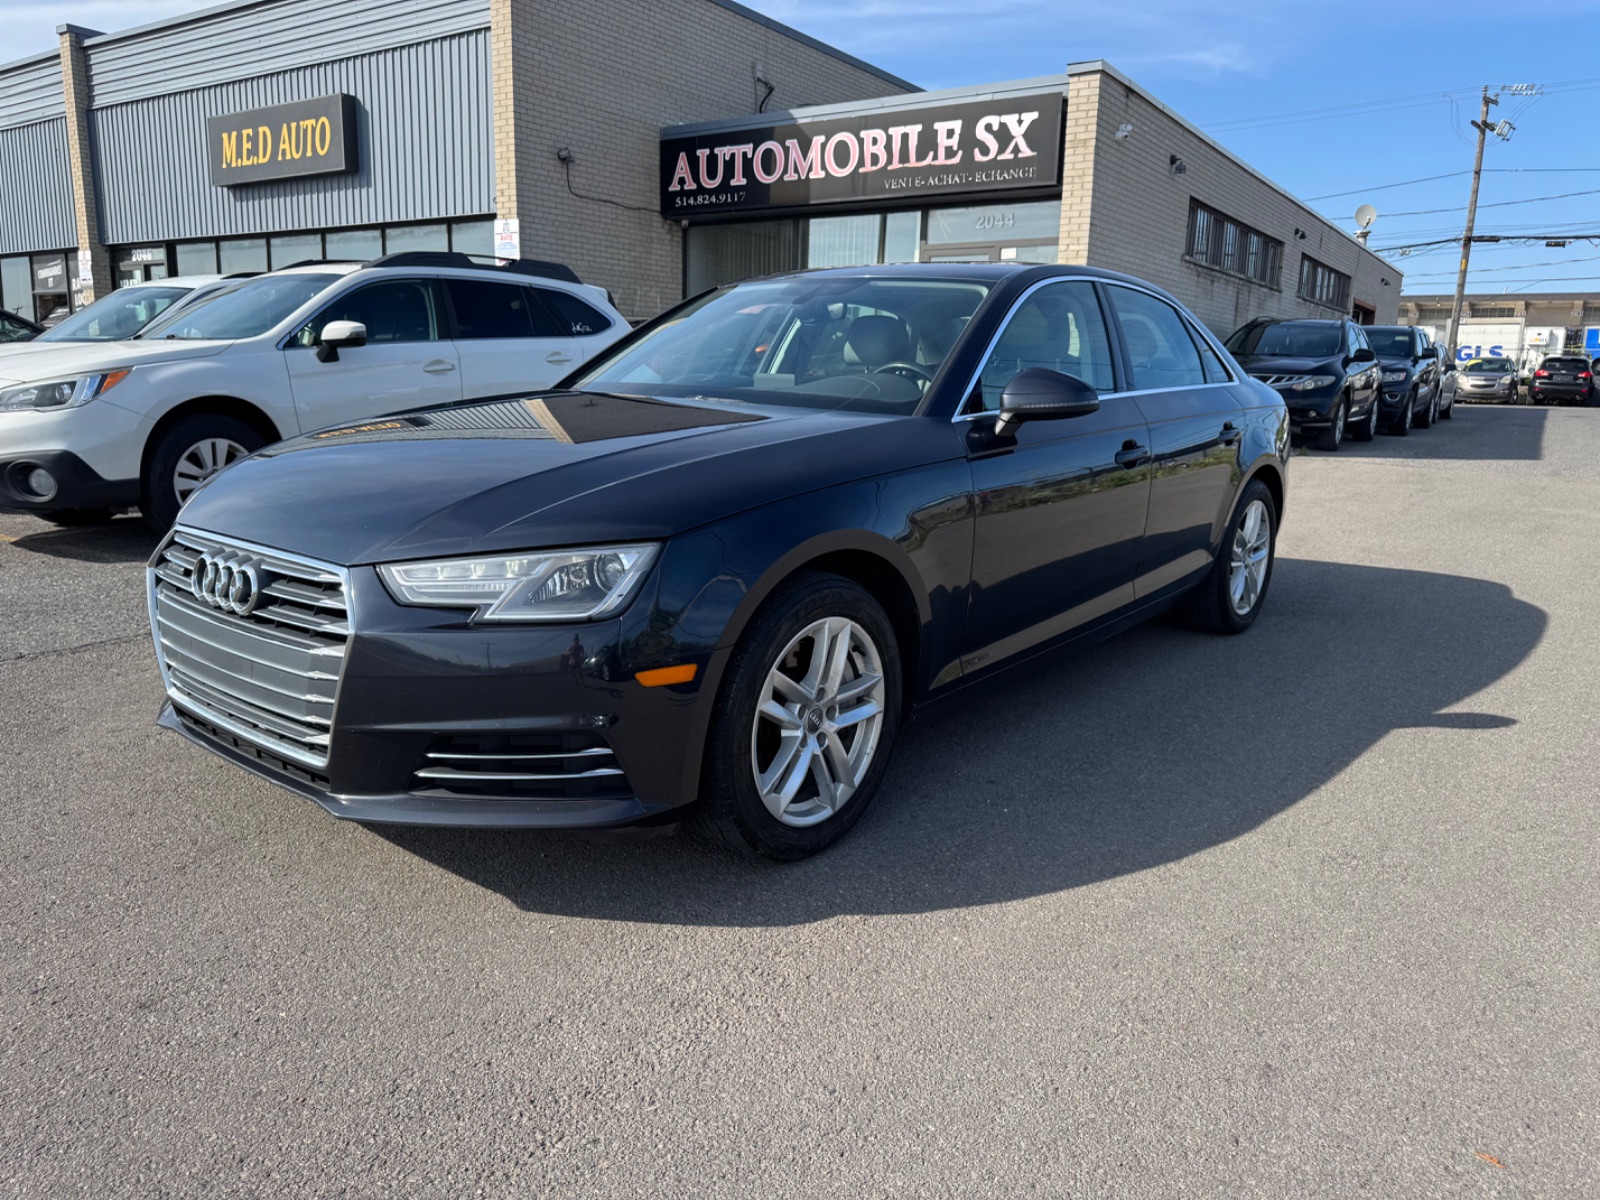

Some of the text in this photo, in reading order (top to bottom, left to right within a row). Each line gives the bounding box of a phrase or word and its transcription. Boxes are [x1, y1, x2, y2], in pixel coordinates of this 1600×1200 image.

[222, 116, 331, 169] M.E.D AUTO
[668, 111, 1039, 192] AUTOMOBILE SX
[675, 191, 746, 207] 514.824.9117
[975, 212, 1015, 229] 2044
[1457, 345, 1503, 362] GLS
